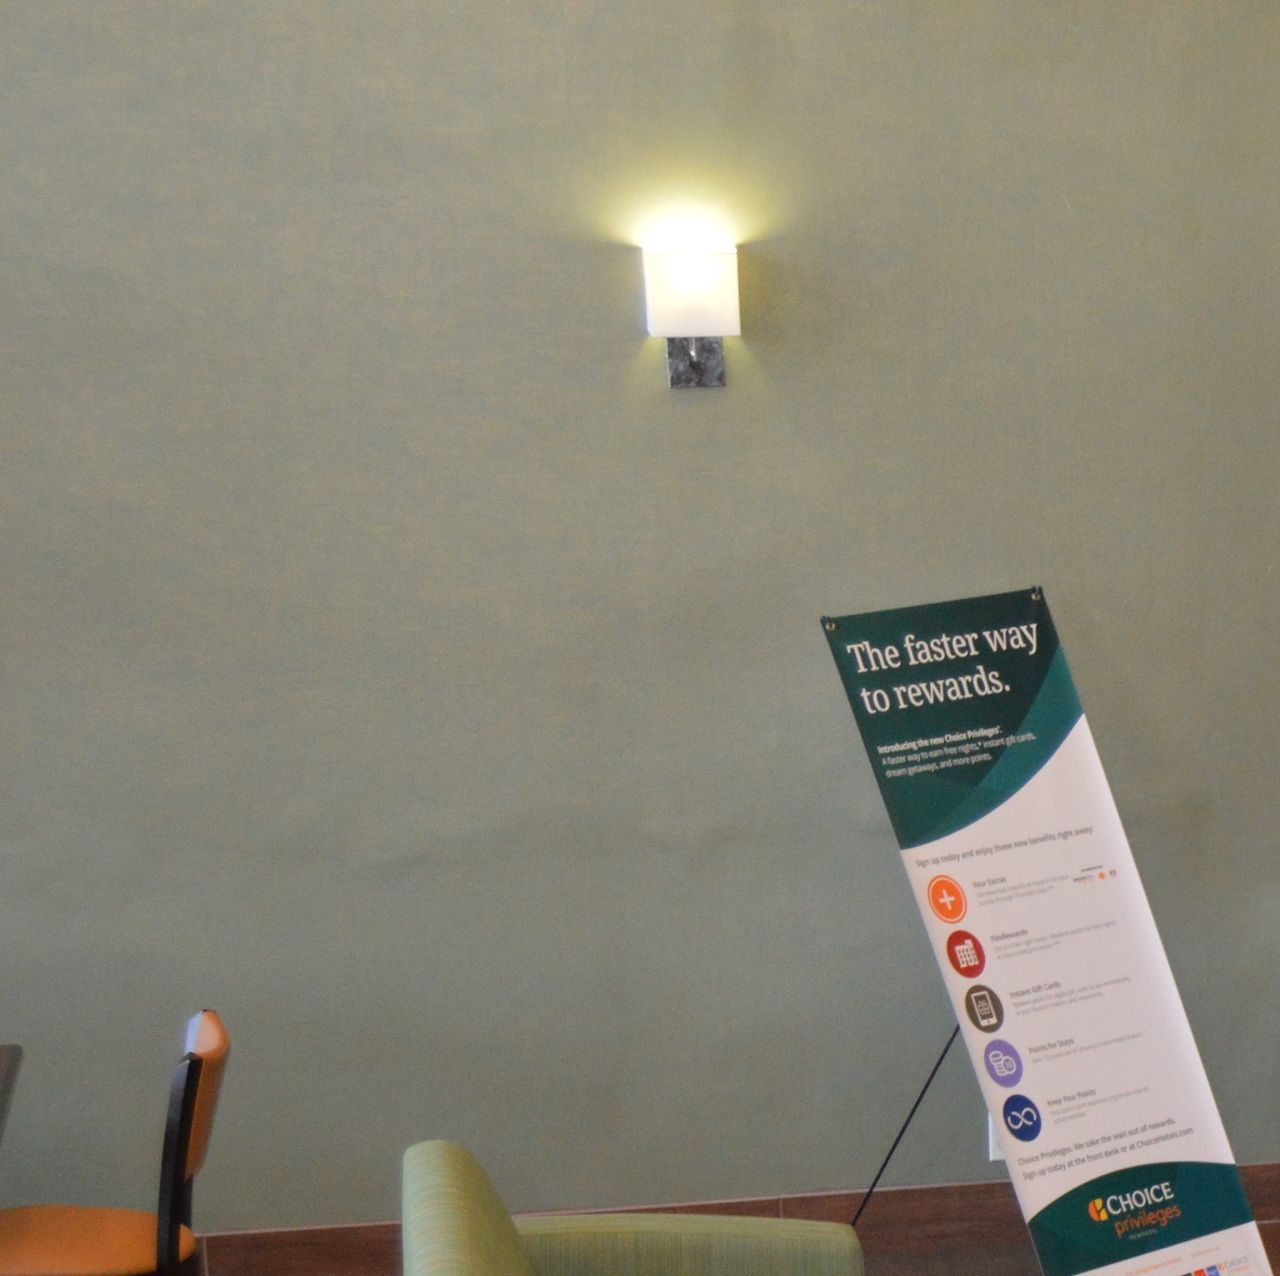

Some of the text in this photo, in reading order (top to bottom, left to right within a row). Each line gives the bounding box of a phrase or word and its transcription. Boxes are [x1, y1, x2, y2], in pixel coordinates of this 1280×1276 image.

[847, 623, 1038, 674] The faster way
[860, 665, 1011, 715] to rewards.
[877, 741, 919, 754] Introducing
[917, 739, 929, 748] the
[930, 737, 945, 745] new
[945, 732, 967, 743] Choice
[887, 755, 906, 765] faster
[907, 753, 920, 762] way
[915, 858, 929, 868] Sign
[940, 853, 960, 862] today
[961, 849, 974, 859] and
[975, 847, 993, 857] enjoy
[993, 843, 1013, 852] these
[1013, 840, 1028, 848] new
[1028, 833, 1056, 845] benefits
[1057, 830, 1073, 840] right
[972, 876, 1007, 888] Your Extras
[1009, 981, 1061, 998] Instant Gift Cards
[1029, 1044, 1048, 1054] Points
[1057, 1038, 1075, 1048] Stays
[1047, 1087, 1096, 1107] Keep Your Points
[1018, 1154, 1040, 1166] Choice
[1072, 1142, 1084, 1151] We
[1085, 1138, 1099, 1148] take
[1100, 1134, 1112, 1144] the
[1113, 1130, 1128, 1140] wait
[1127, 1127, 1139, 1137] out
[1022, 1170, 1037, 1181] Sign
[1047, 1162, 1066, 1174] today
[1074, 1156, 1086, 1166] the
[1086, 1151, 1103, 1162] front
[1103, 1146, 1119, 1158] desk
[1106, 1181, 1174, 1215] CHOICE
[1114, 1203, 1182, 1239] privileges
